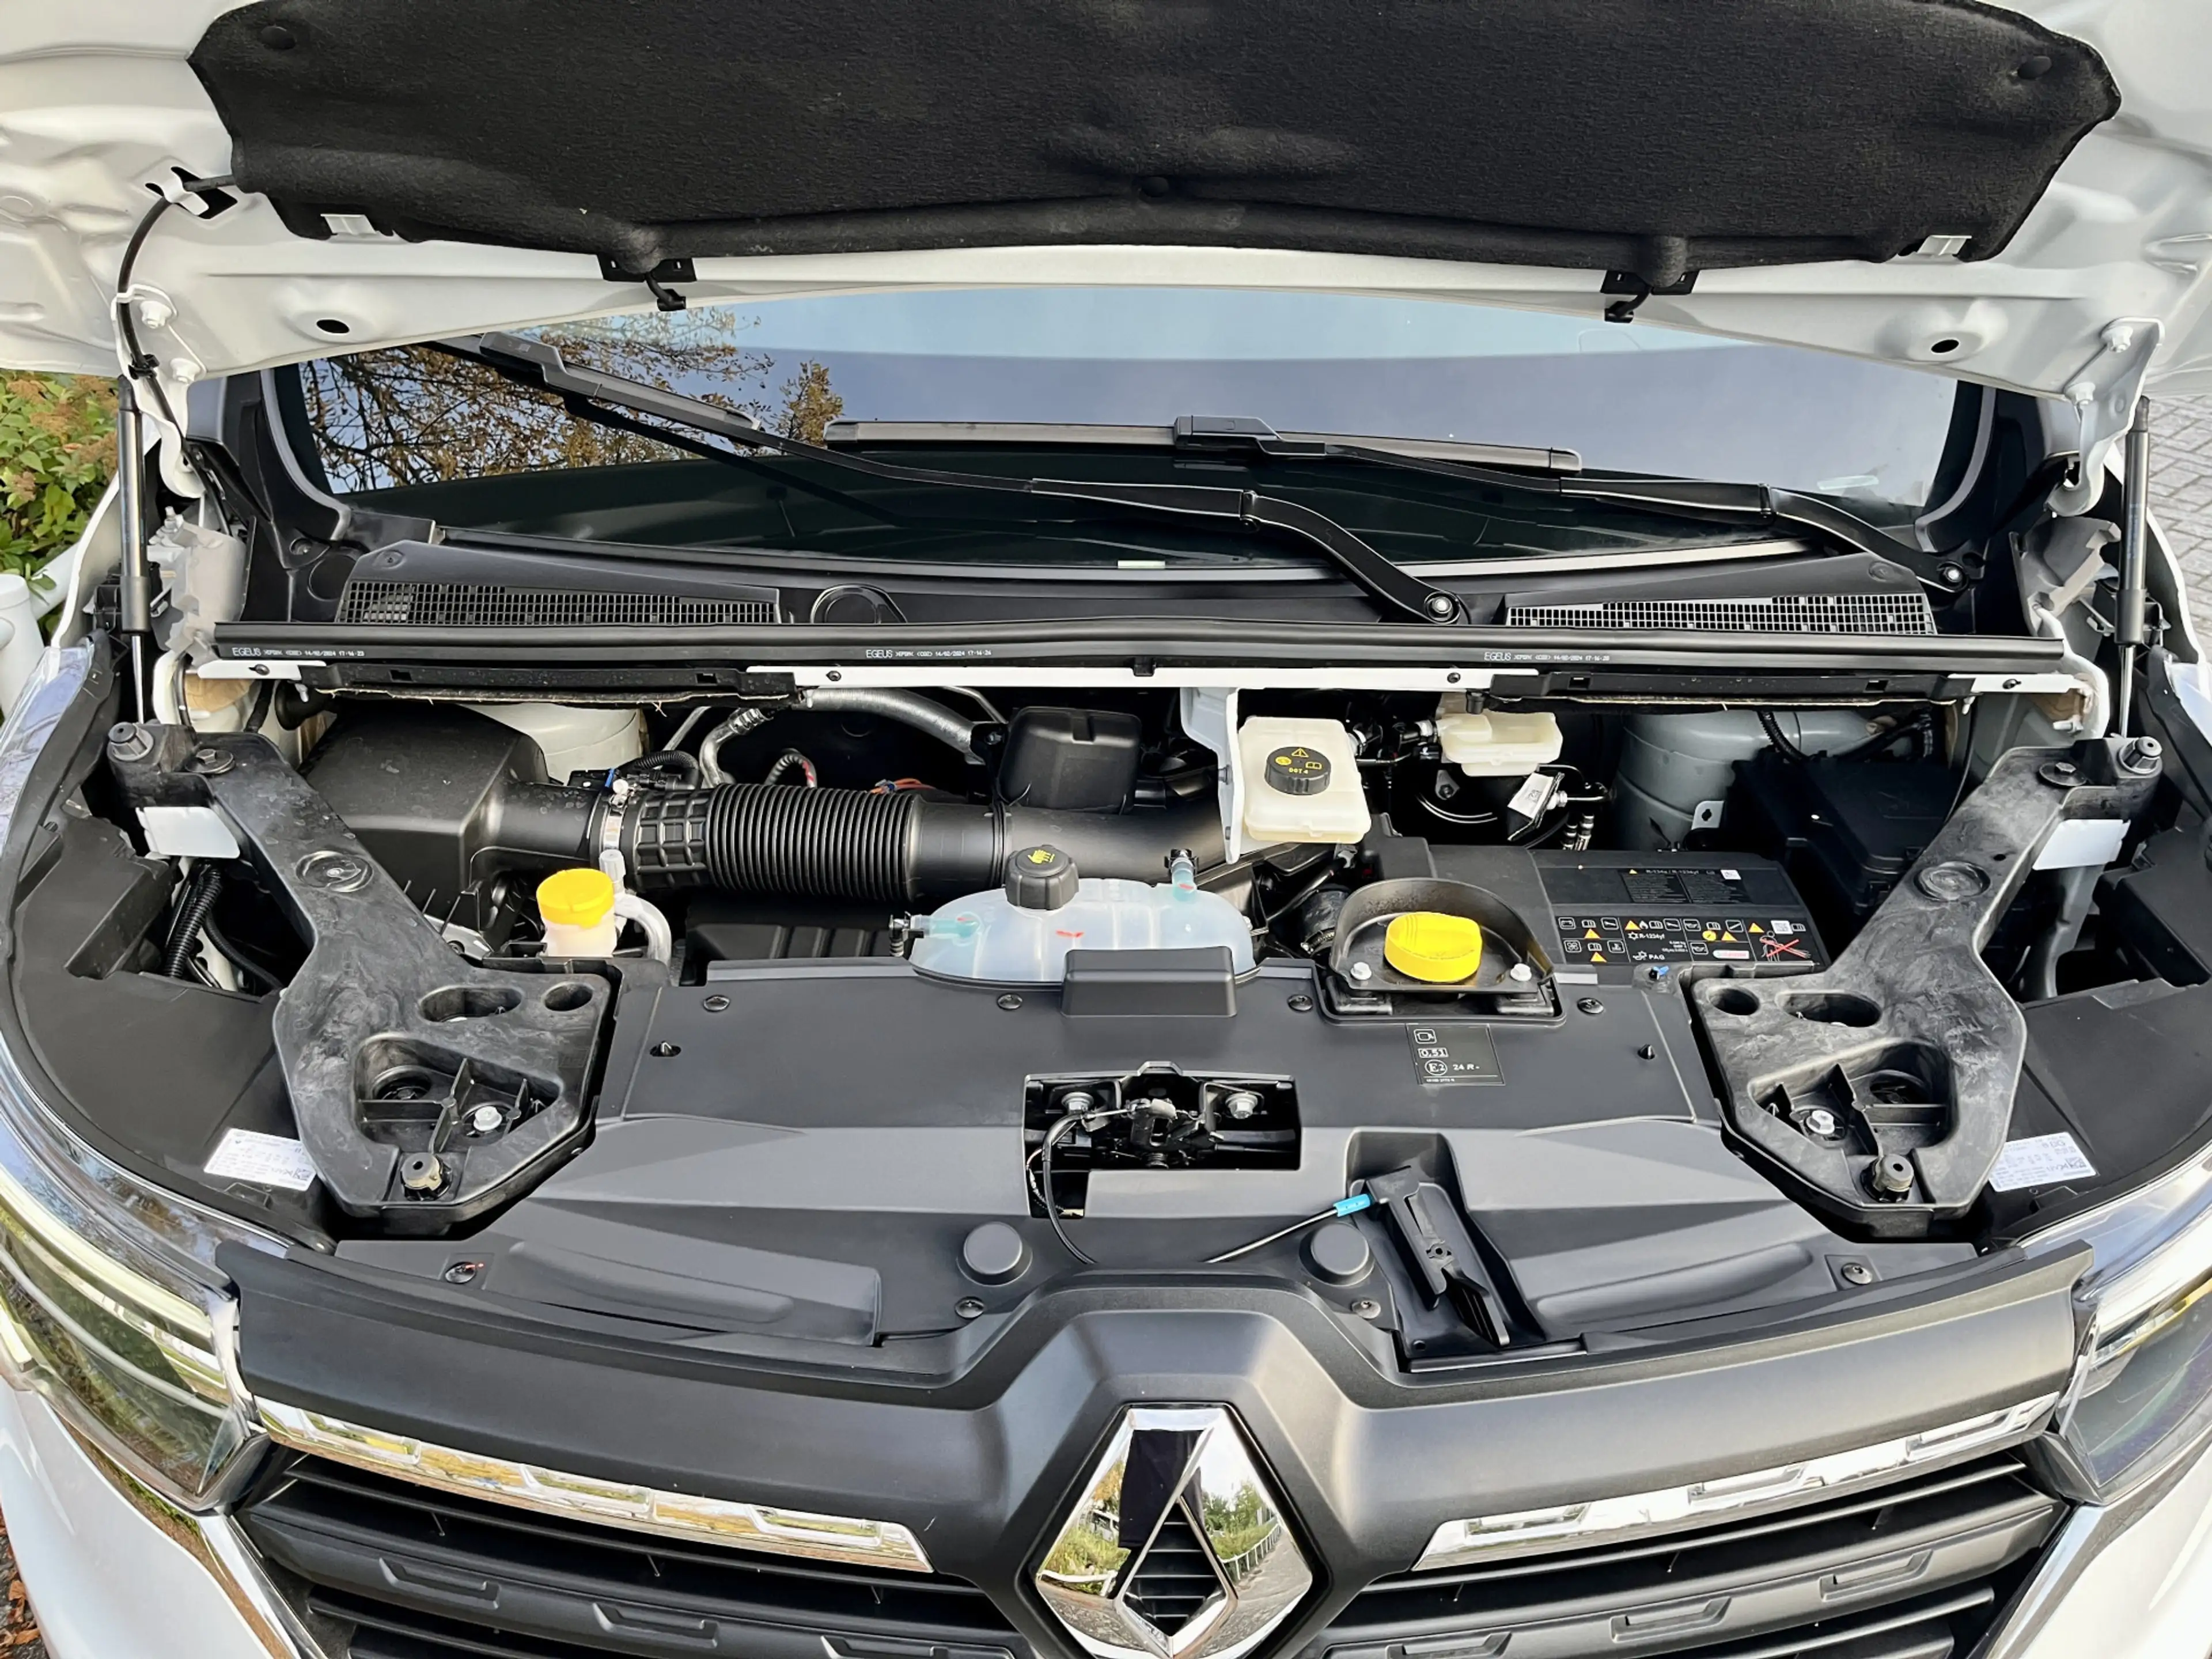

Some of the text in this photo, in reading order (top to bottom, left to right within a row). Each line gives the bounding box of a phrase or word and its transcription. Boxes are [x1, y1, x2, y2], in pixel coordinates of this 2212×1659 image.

[232, 647, 262, 657] EGEUS
[866, 650, 893, 658] EGEUS
[1484, 652, 1512, 661] EGEUS
[1429, 1063, 1445, 1072] E2
